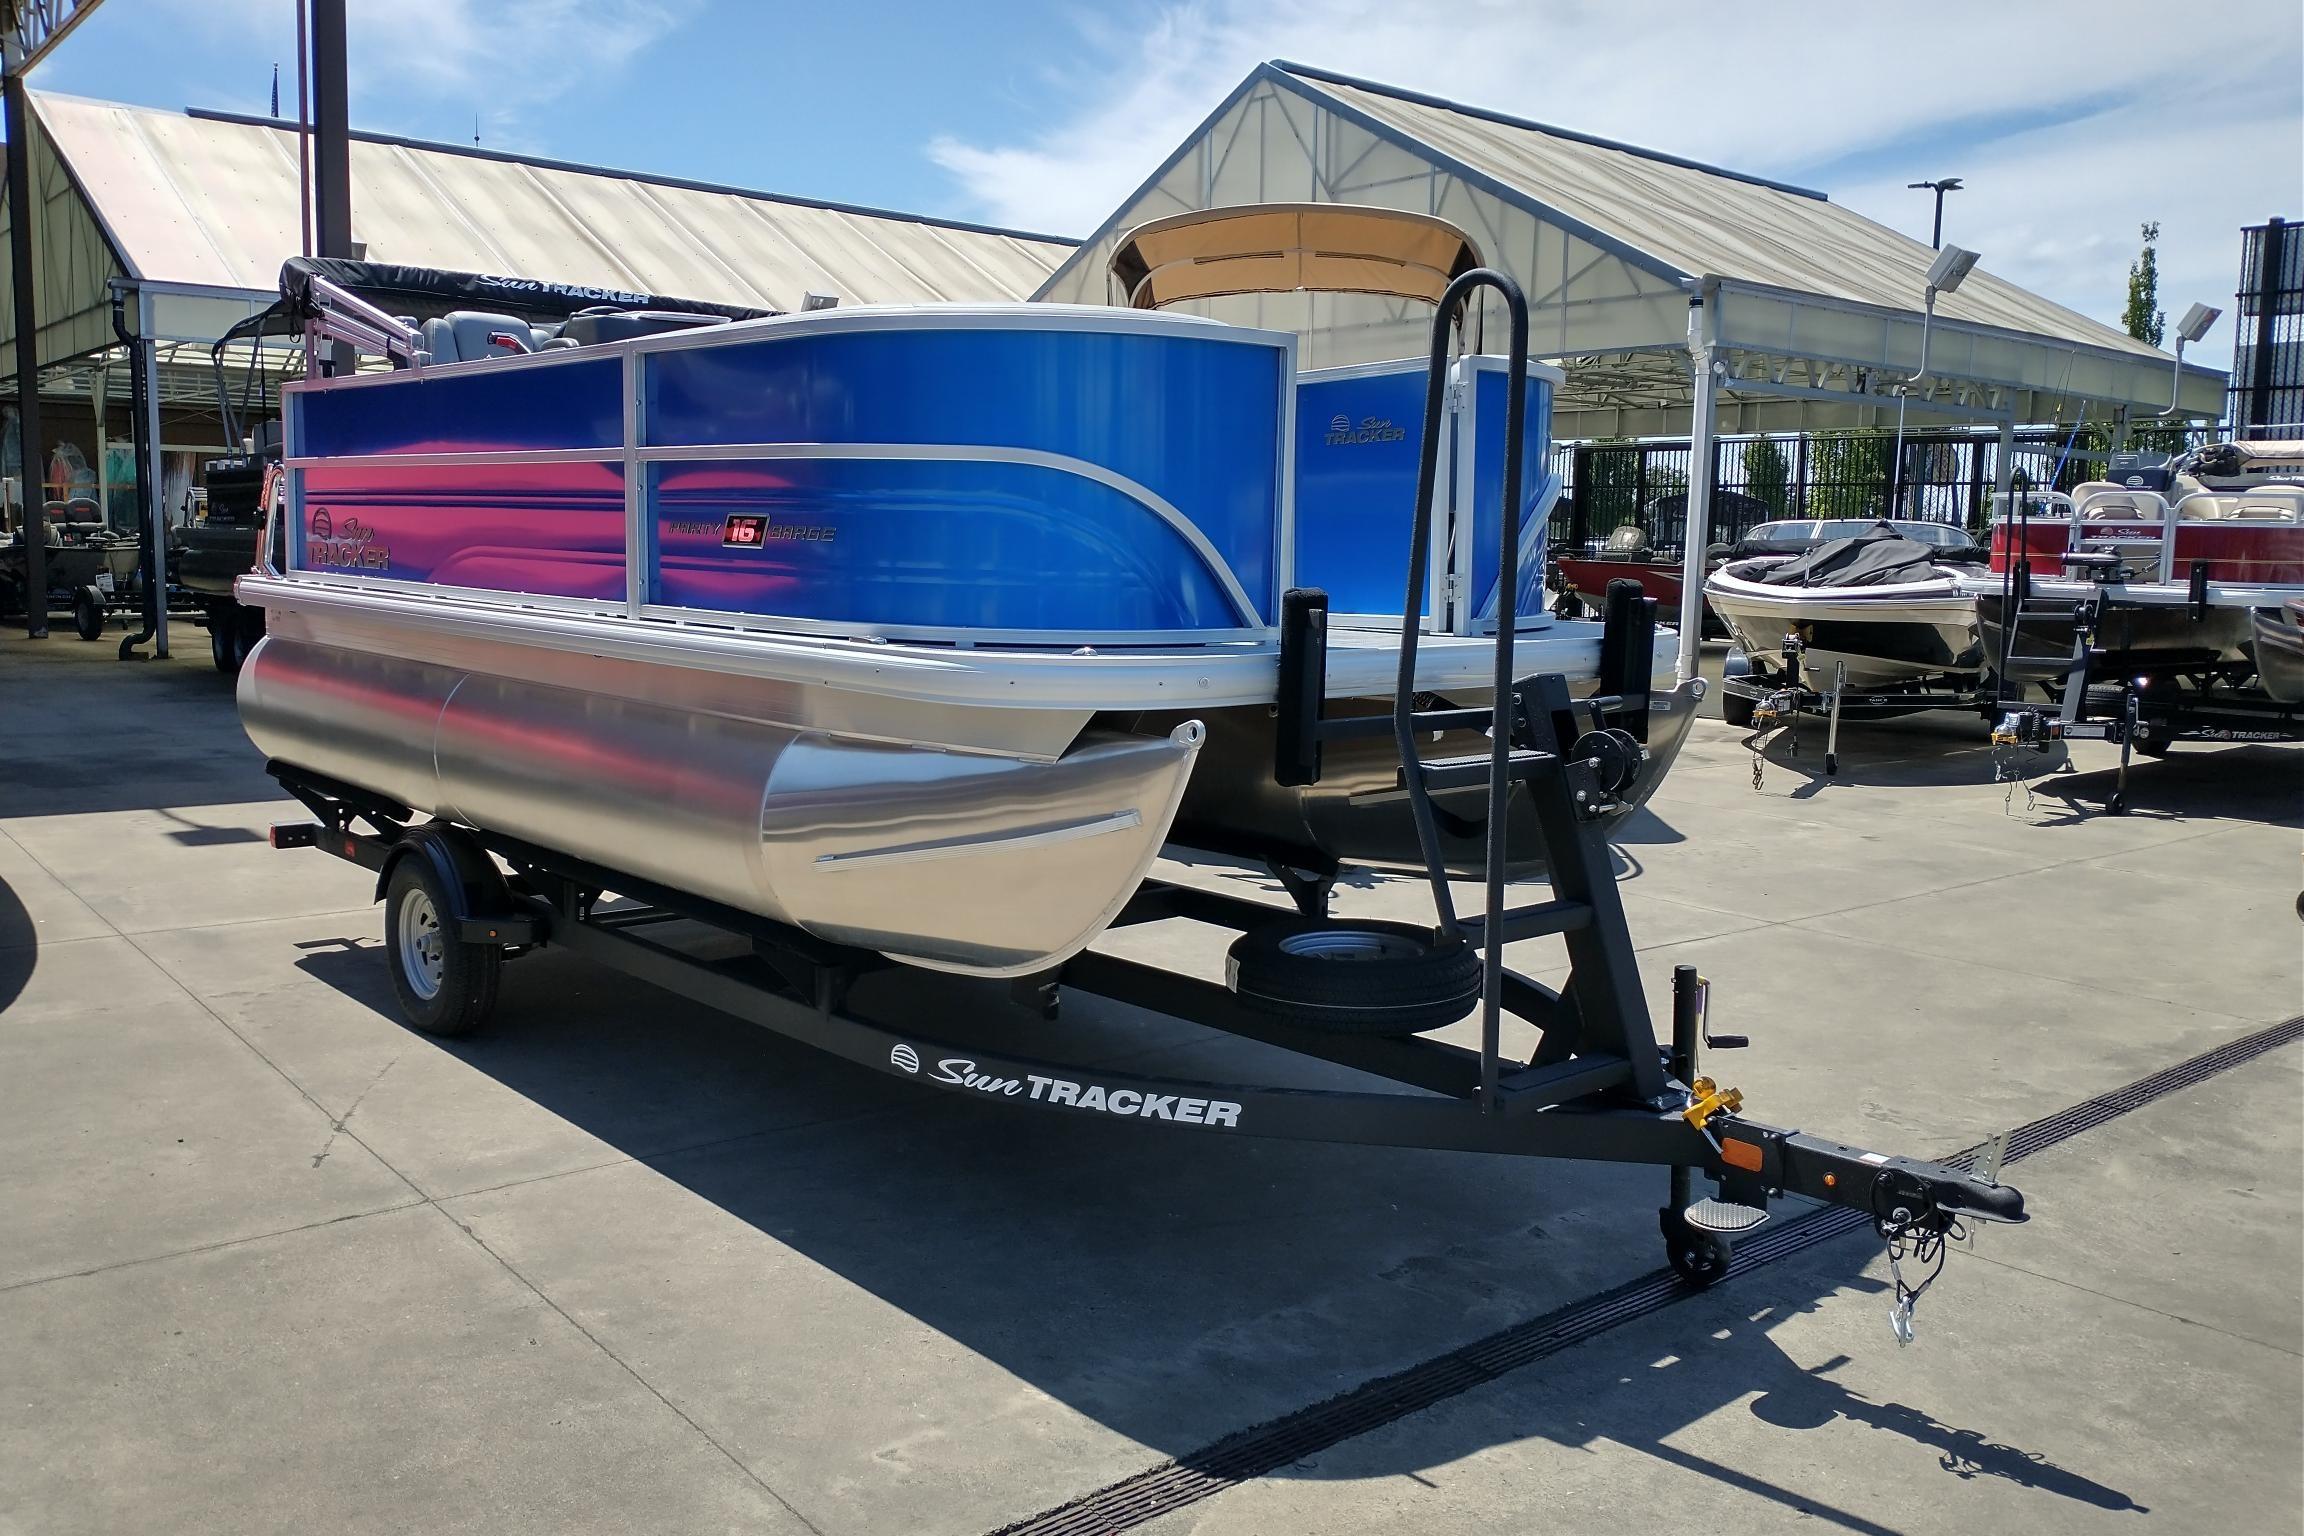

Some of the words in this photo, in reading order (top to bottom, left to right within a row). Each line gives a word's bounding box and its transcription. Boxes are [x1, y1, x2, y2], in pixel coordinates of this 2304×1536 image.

[475, 273, 540, 292] Sun
[541, 281, 651, 304] TRACKER
[1356, 416, 1392, 430] Sun
[1324, 428, 1405, 446] TRACKER
[339, 518, 375, 543] Sun
[668, 521, 722, 535] PARTY
[731, 518, 758, 542] 16
[769, 525, 837, 542] BARGE
[2231, 731, 2280, 740] TRACKER
[927, 1058, 1023, 1096] Sun
[1027, 1074, 1243, 1128] TRACKER
